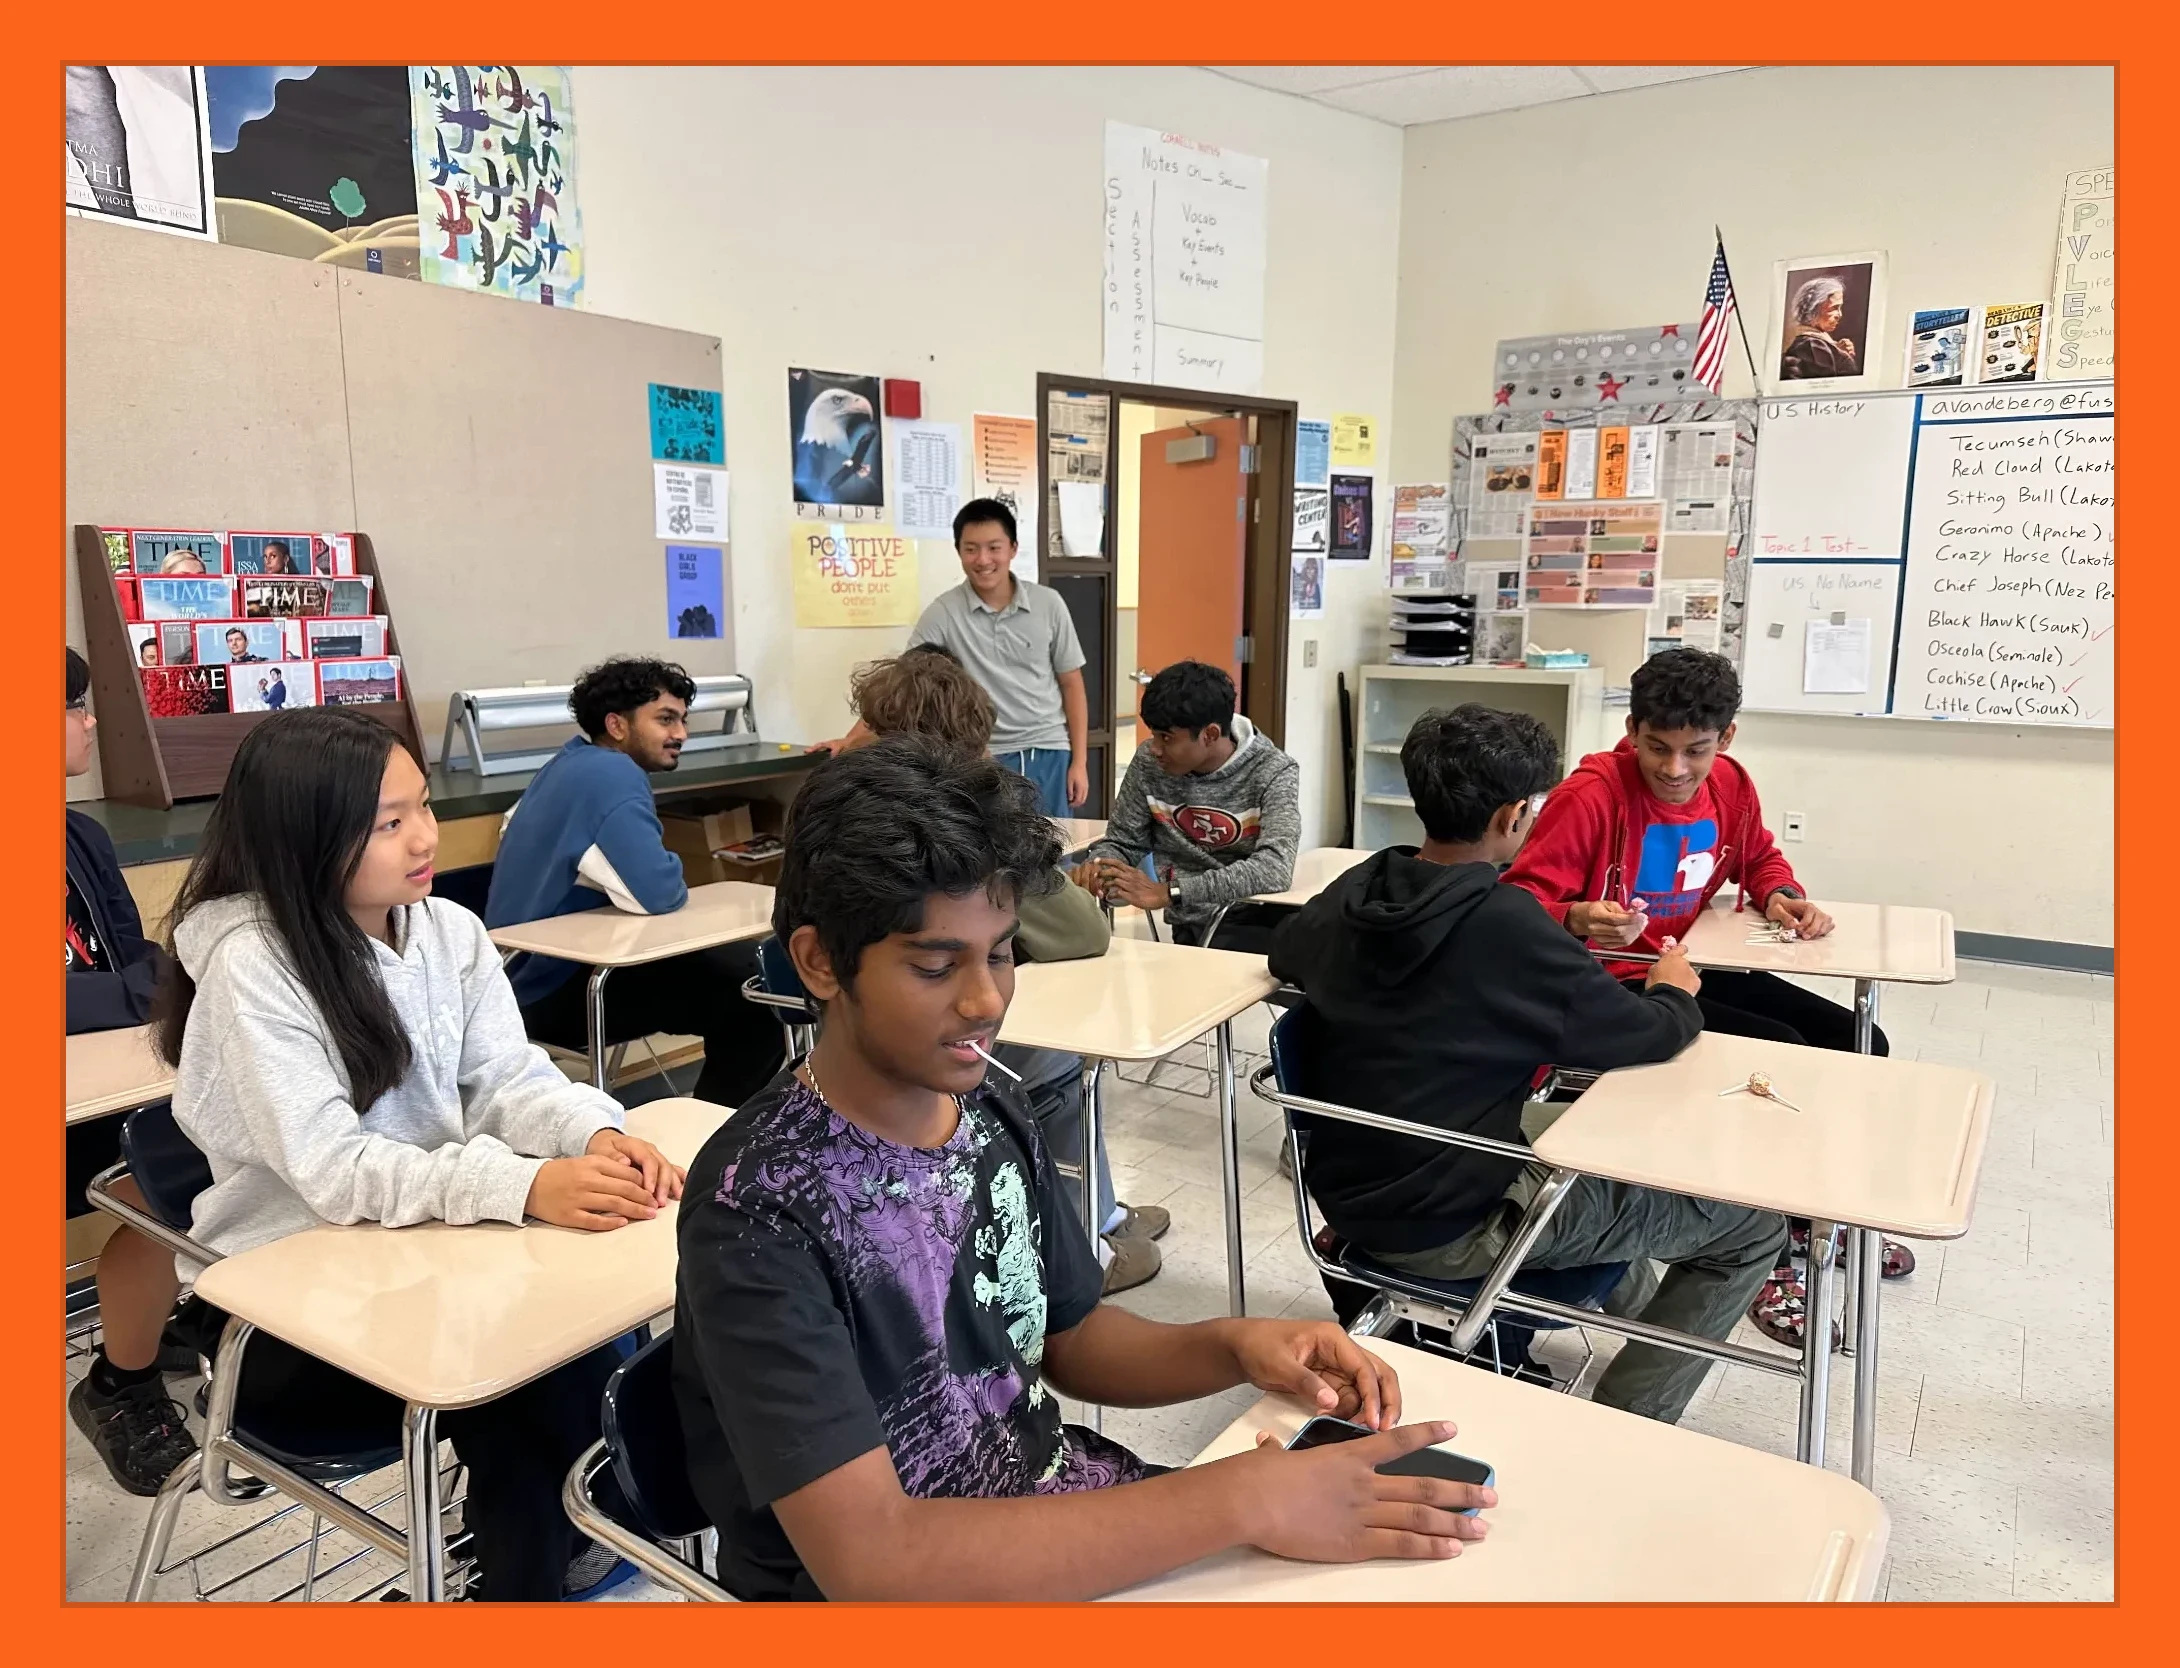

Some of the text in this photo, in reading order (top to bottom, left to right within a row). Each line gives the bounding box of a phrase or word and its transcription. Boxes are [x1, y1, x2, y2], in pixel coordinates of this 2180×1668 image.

[1142, 146, 1178, 174] Notes
[95, 193, 130, 208] WHOLE
[1182, 202, 1218, 227] Vocab
[1182, 237, 1225, 256] Key Events
[1179, 270, 1219, 290] Key People
[2062, 292, 2102, 318] Eye
[1915, 310, 1965, 330] STORYTELLER
[1986, 305, 2041, 327] DETECTIVE
[1177, 348, 1223, 377] Summary
[1809, 401, 1865, 417] History
[1949, 428, 2114, 451] Tecumseh (Shaw
[1951, 458, 1984, 477] Red
[1994, 456, 2042, 476] Cloud
[1947, 489, 2006, 513] Sitting
[2019, 486, 2053, 504] Bull
[797, 504, 883, 520] PRIDE
[1297, 508, 1326, 526] CENTER
[1939, 519, 2013, 537] Geronimo
[807, 535, 905, 557] POSITIVE
[1760, 535, 1796, 554] Topic
[237, 560, 259, 571] ISSA
[1935, 545, 1992, 566] Crazy
[2003, 547, 2050, 563] Horse
[818, 557, 897, 578] PEOPLE
[153, 581, 221, 601] TIME
[867, 582, 890, 594] put
[1838, 573, 1883, 591] Name
[1934, 578, 1977, 593] Chief
[1987, 576, 2041, 597] Joseph
[2095, 582, 2114, 600] Pe
[260, 586, 318, 607] TIME
[1928, 609, 1971, 628] Black
[1980, 611, 2027, 630] Hawk
[205, 625, 273, 646] TE
[319, 623, 375, 642] TIME
[1928, 640, 1984, 657] Osceola
[1927, 668, 1986, 687] Cochise
[1924, 694, 1970, 713] Little
[1976, 696, 2013, 715] Crow
